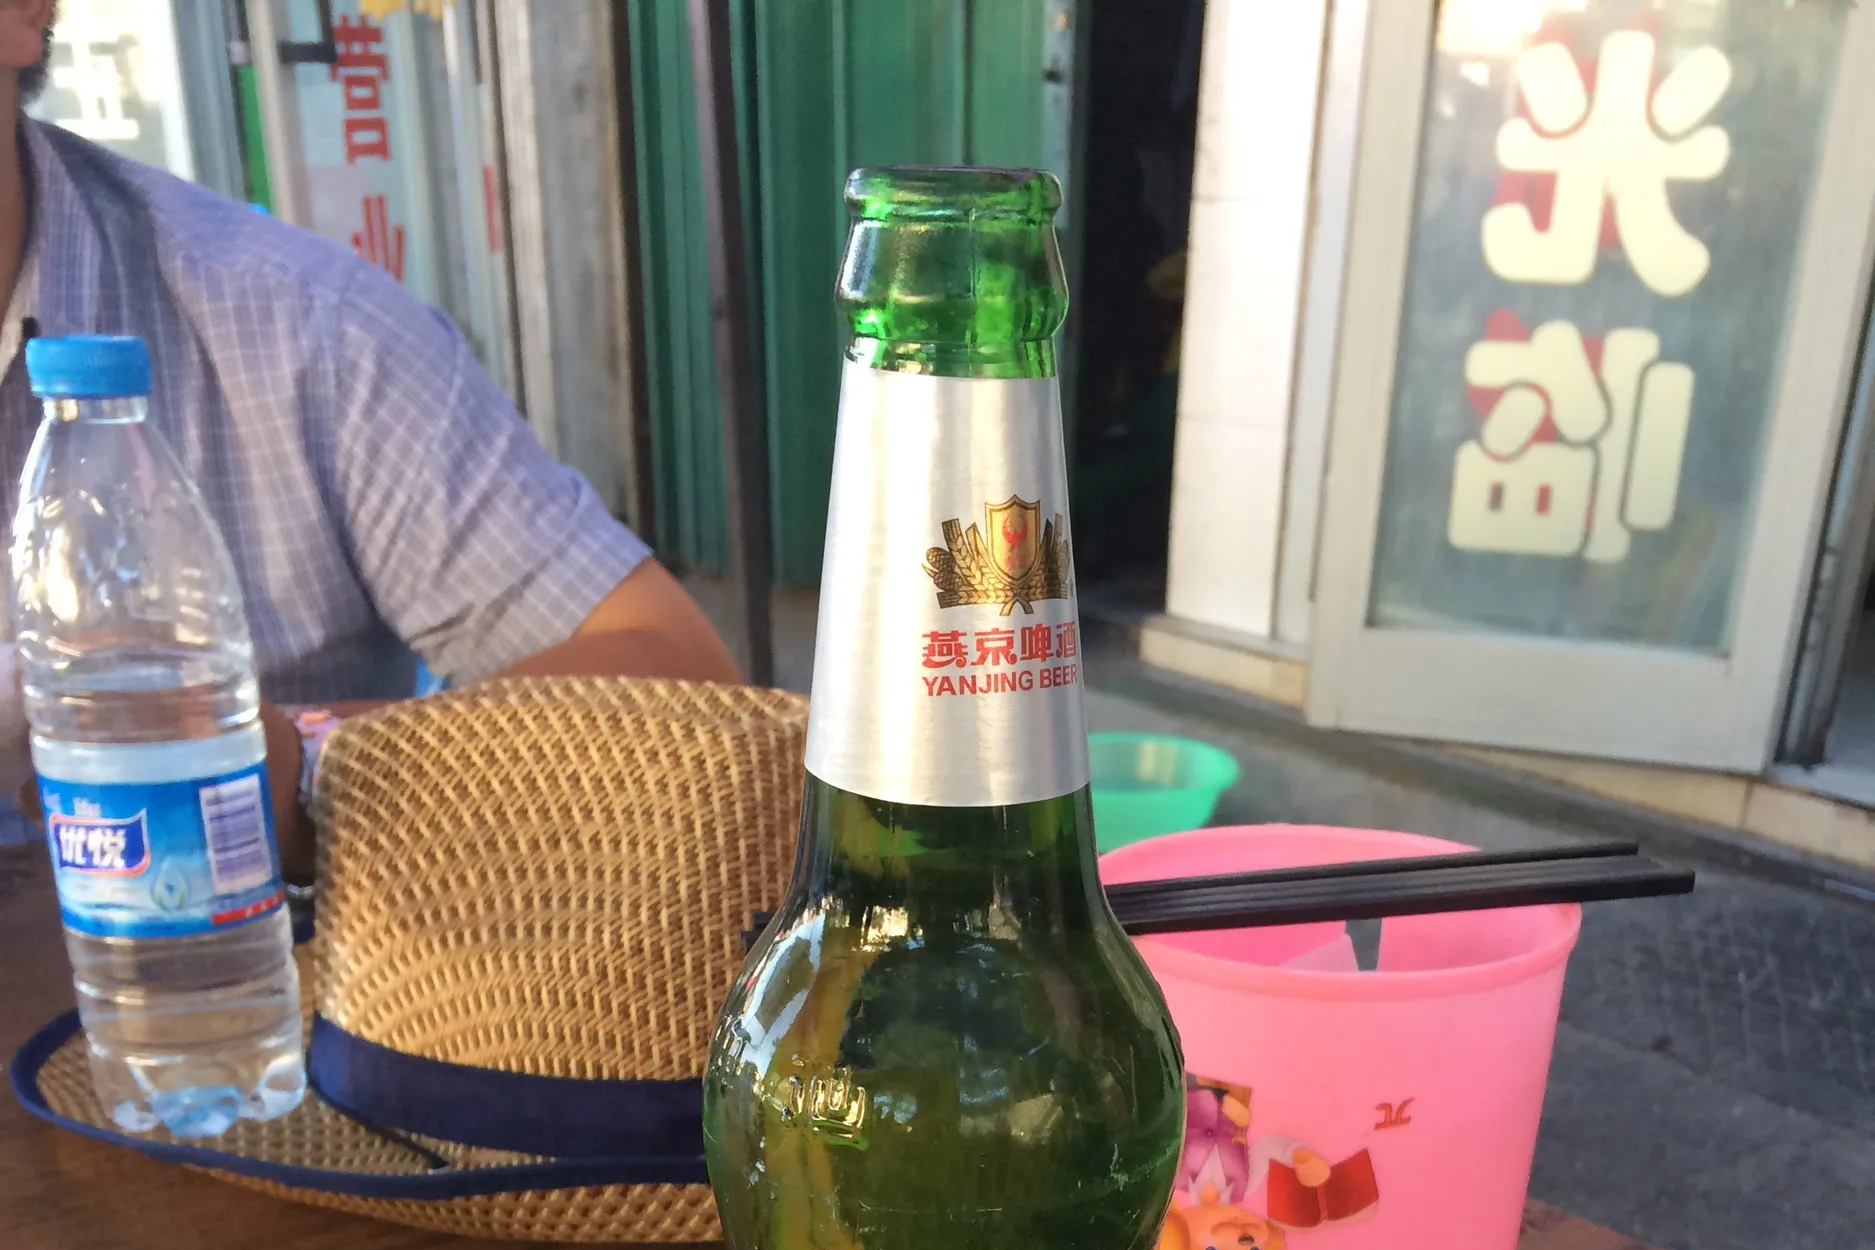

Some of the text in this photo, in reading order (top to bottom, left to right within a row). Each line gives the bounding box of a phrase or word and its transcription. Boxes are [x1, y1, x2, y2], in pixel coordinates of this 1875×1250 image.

[921, 620, 1077, 669] 燕京啤酒
[921, 663, 1078, 697] YANJING BEER
